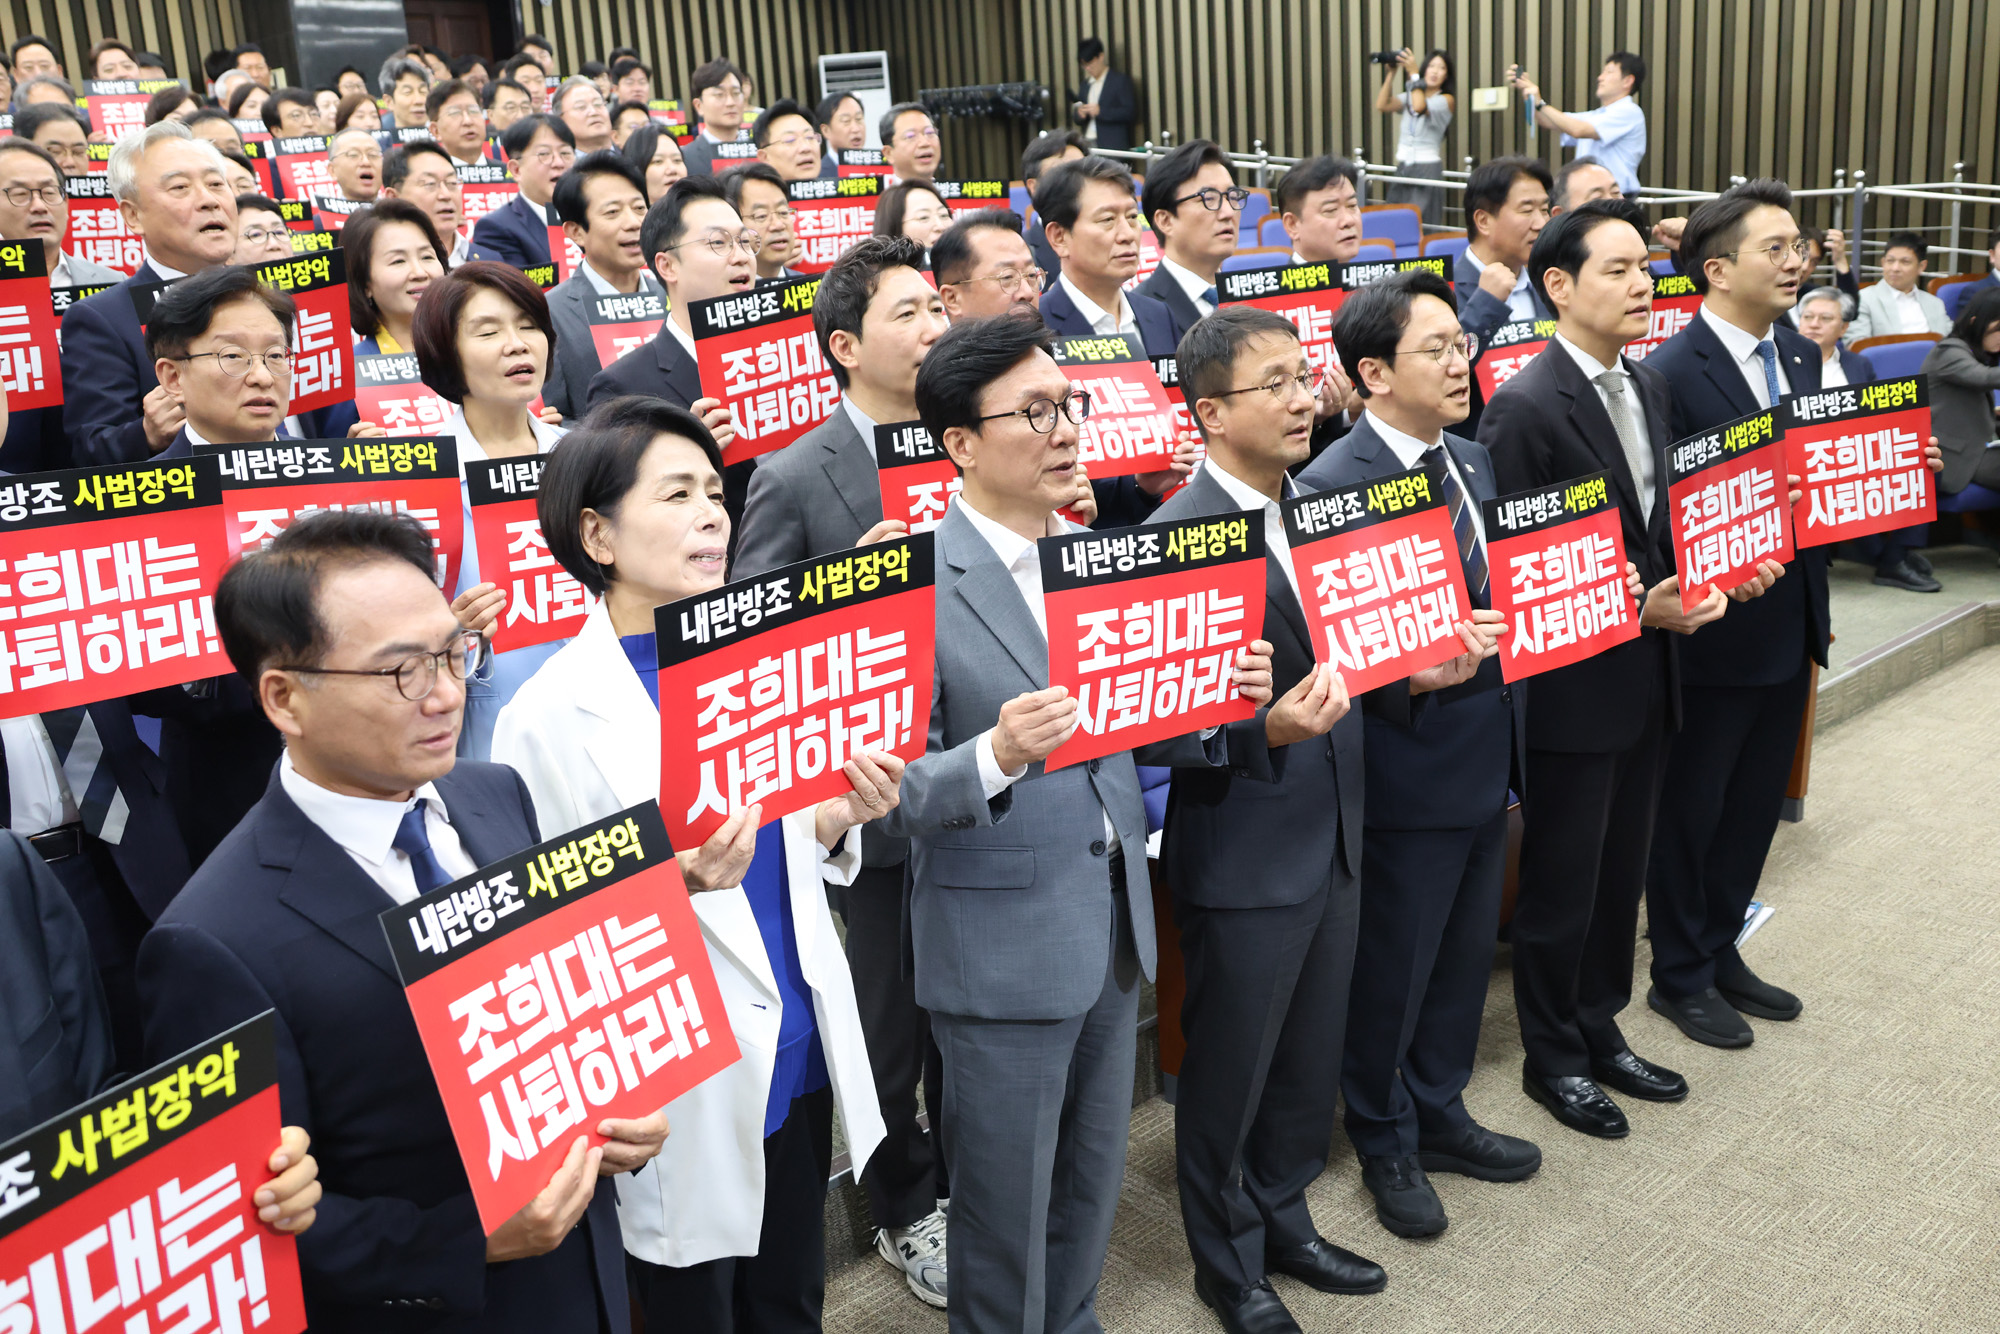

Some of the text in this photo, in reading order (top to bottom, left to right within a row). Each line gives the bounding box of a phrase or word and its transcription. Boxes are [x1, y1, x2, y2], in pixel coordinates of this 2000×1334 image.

[101, 102, 148, 124] 조희
[457, 166, 504, 182] 내란방조
[790, 180, 837, 199] 내란방조
[838, 177, 878, 197] 사법장악
[932, 180, 1003, 198] 방조 사법장악
[71, 208, 134, 239] 조희
[280, 203, 304, 221] 장악
[463, 192, 516, 218] 조희
[798, 205, 876, 237] 조희대는
[289, 231, 333, 251] 법장악
[596, 295, 664, 320] 내란방조
[1225, 264, 1331, 298] 내란방조 사법장악
[706, 291, 781, 329] 내란방조
[1272, 304, 1333, 342] 대는
[720, 330, 834, 398] 조희대
[1064, 337, 1133, 362] 사법장악
[379, 394, 459, 437] 조희
[728, 374, 842, 442] 사퇴하
[1792, 379, 1918, 421] 내란방조 사법장악
[218, 441, 438, 482] 내란방조 사법장악
[892, 427, 935, 458] 내란
[1077, 414, 1175, 464] 퇴하라!
[1673, 412, 1773, 474] 내란방조 사법장악
[1804, 427, 1919, 484] 조희대는
[0, 465, 196, 522] 방조 사법장악
[488, 461, 545, 494] 내란
[1294, 472, 1432, 535] 내란방조 사법장악
[1497, 477, 1608, 531] 내란방조 사법장악
[1680, 466, 1776, 542] 조희대는
[1807, 468, 1926, 529] 사퇴하라!
[1061, 518, 1249, 578] 내란방조 사법장악
[1311, 533, 1447, 618] 조희대는
[1509, 532, 1618, 605] 조희대는
[1684, 507, 1783, 592] 사퇴하라!
[680, 544, 912, 644] 내란방조 사법장악
[1511, 577, 1629, 659] 사퇴하라!
[1077, 588, 1245, 675] 조희대는
[1324, 583, 1461, 674] 사퇴하라!
[696, 626, 907, 752] 조희대는
[1072, 646, 1248, 737] 사퇴하라!
[686, 684, 914, 826] 사퇴하라!
[408, 817, 645, 955] 내란방조 사법장악
[448, 913, 676, 1085] 조희대는
[478, 973, 711, 1183] 사퇴하라!
[50, 1041, 240, 1181] 사법장악
